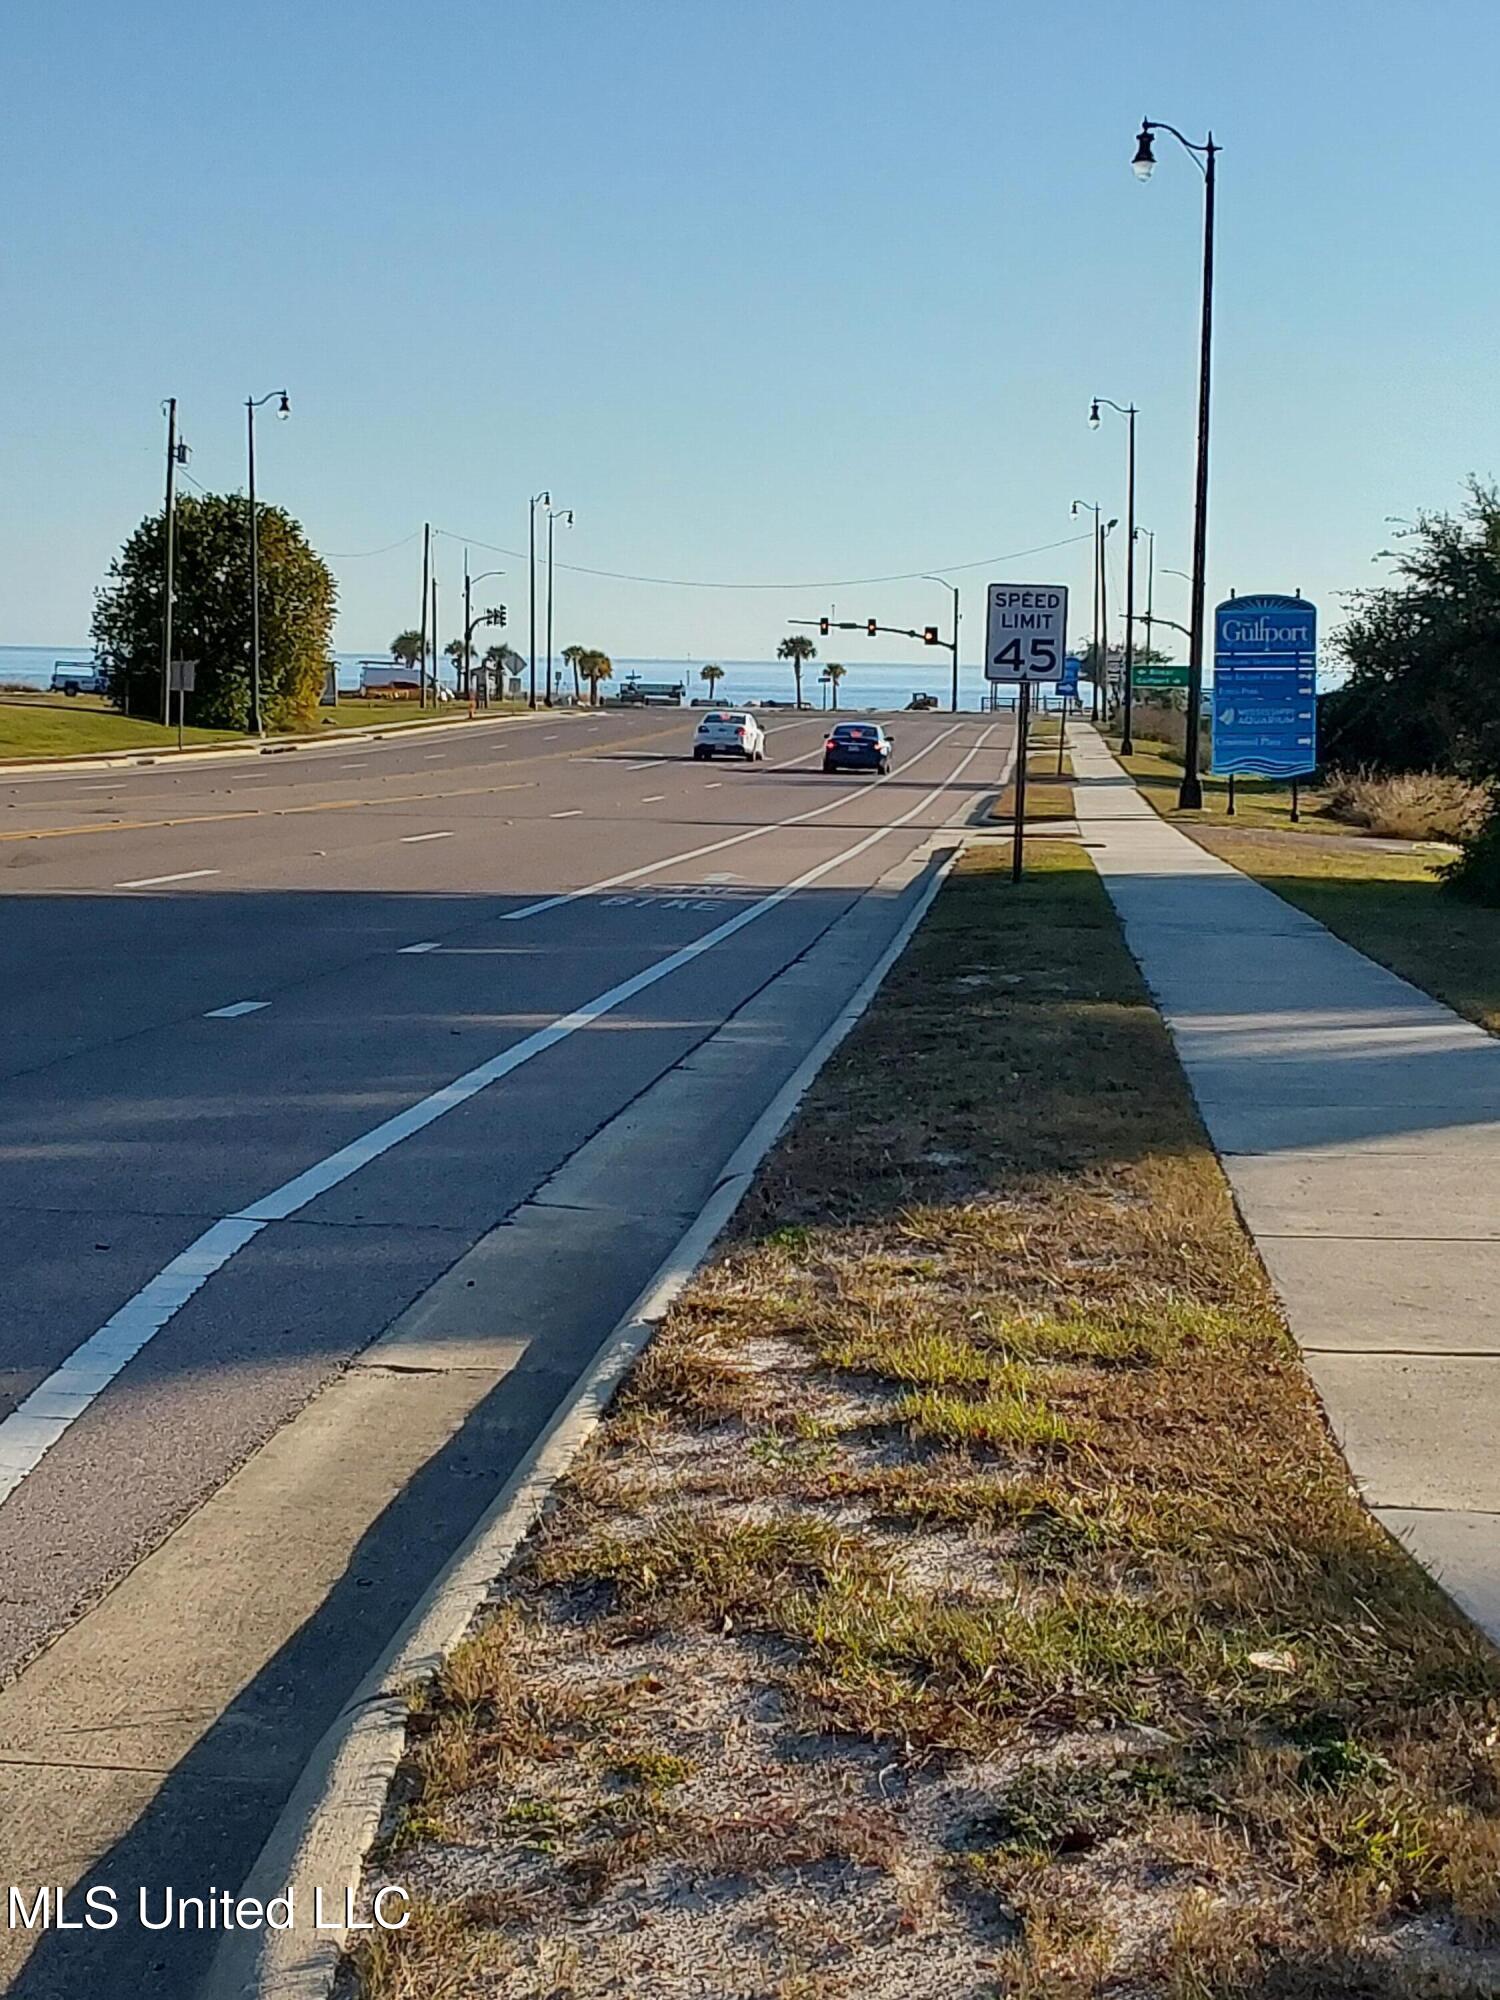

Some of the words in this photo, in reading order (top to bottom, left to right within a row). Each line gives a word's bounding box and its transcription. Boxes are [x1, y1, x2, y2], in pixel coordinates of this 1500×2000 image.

[995, 592, 1060, 609] SPEED
[1001, 613, 1054, 629] LIMIT
[1222, 616, 1308, 652] Gulfport
[993, 638, 1057, 673] 45
